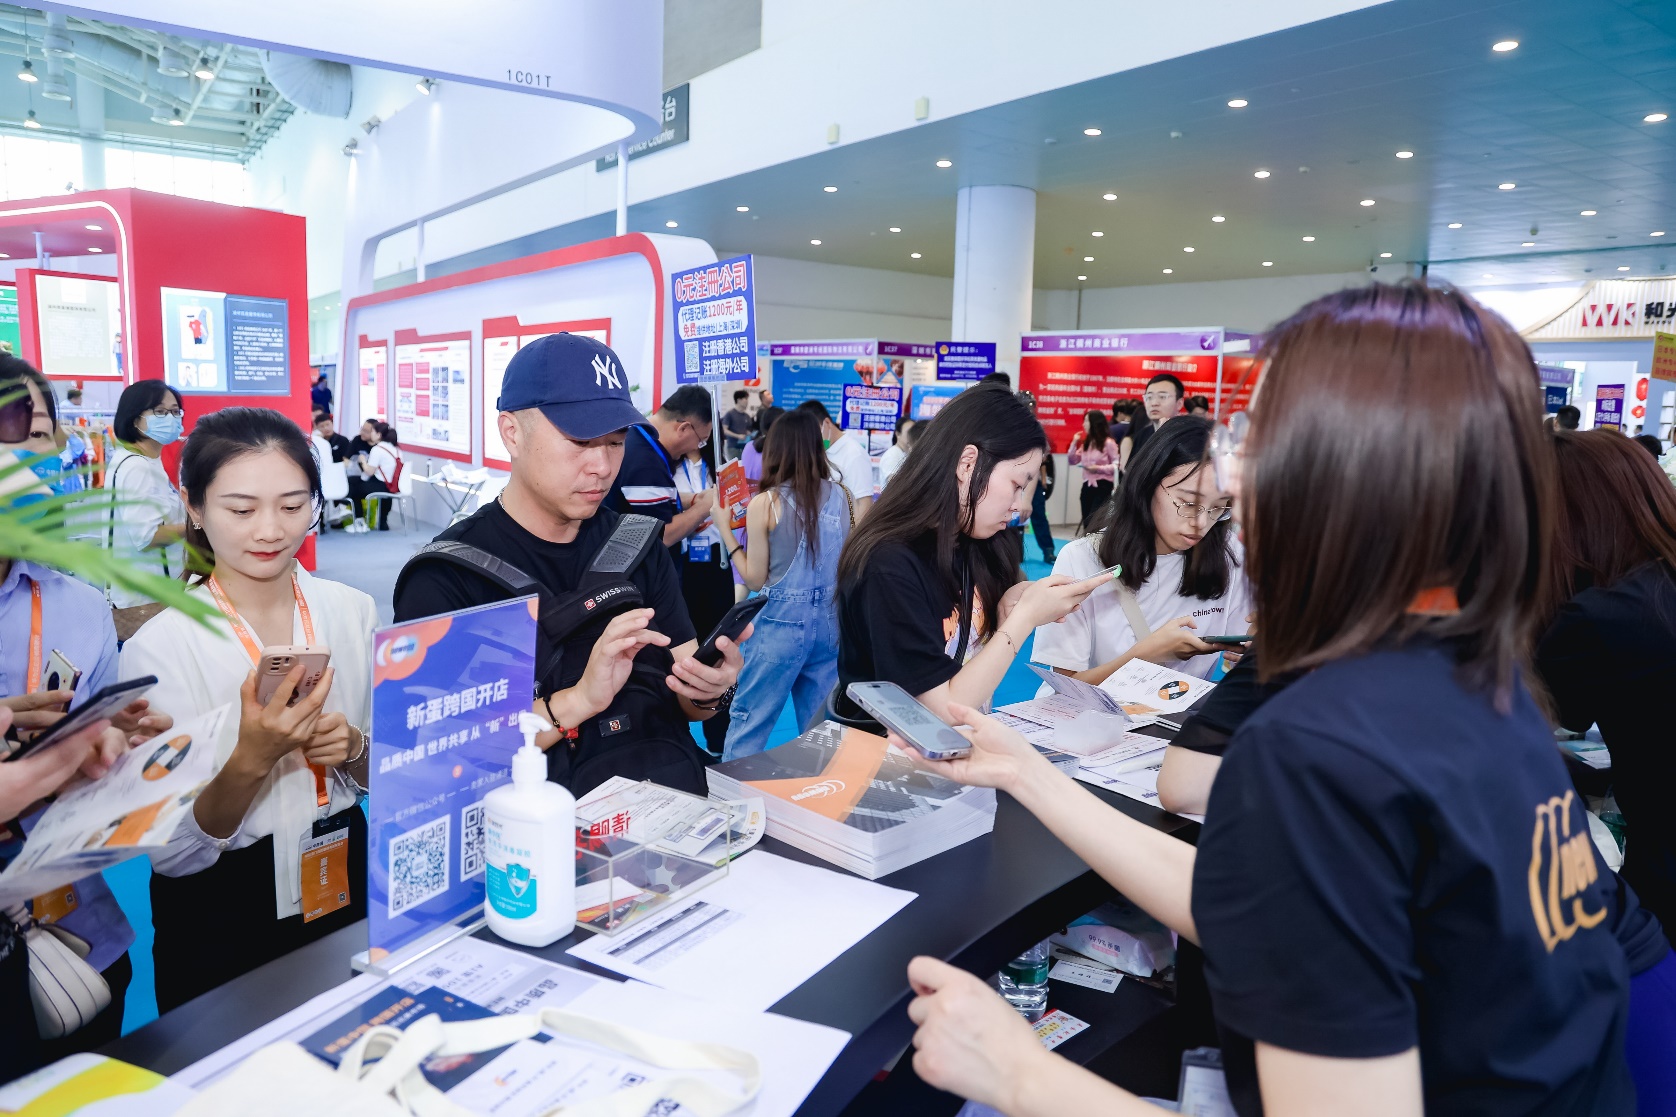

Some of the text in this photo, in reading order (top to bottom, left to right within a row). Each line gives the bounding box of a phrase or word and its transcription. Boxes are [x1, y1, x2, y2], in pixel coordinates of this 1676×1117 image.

[506, 68, 551, 88] 1C01T
[591, 353, 623, 390] NY
[406, 677, 509, 731] 新蛋跨国开店
[379, 743, 425, 774] 品质中国
[427, 731, 468, 756] 世界共享
[470, 725, 481, 742] 从
